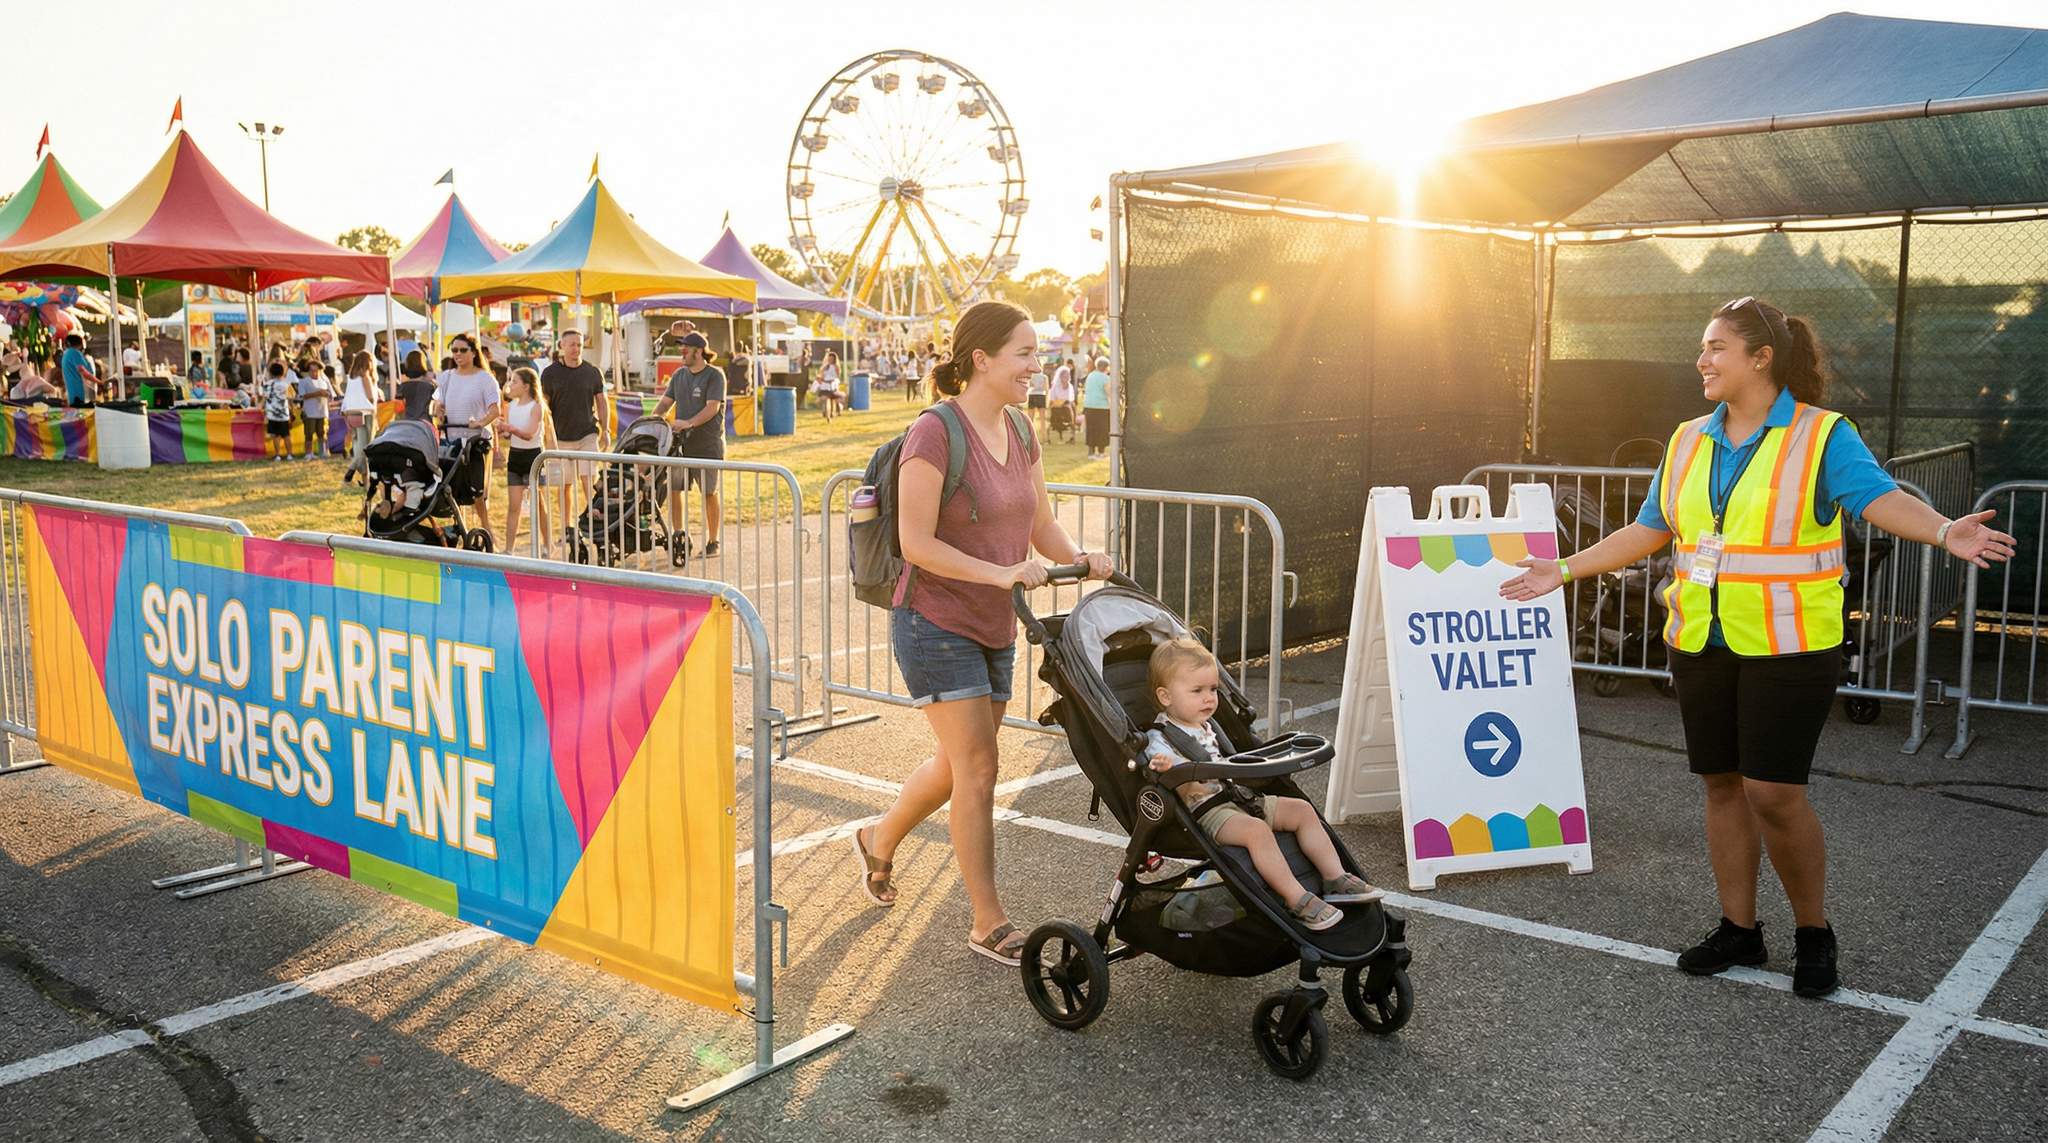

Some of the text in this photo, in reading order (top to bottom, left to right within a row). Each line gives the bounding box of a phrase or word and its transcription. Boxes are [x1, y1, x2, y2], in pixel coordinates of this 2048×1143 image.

[142, 582, 495, 750] SOLO PARENT
[1408, 607, 1552, 645] STROLLER
[1431, 648, 1536, 690] VALET
[147, 672, 498, 860] EXPRESS LANE
